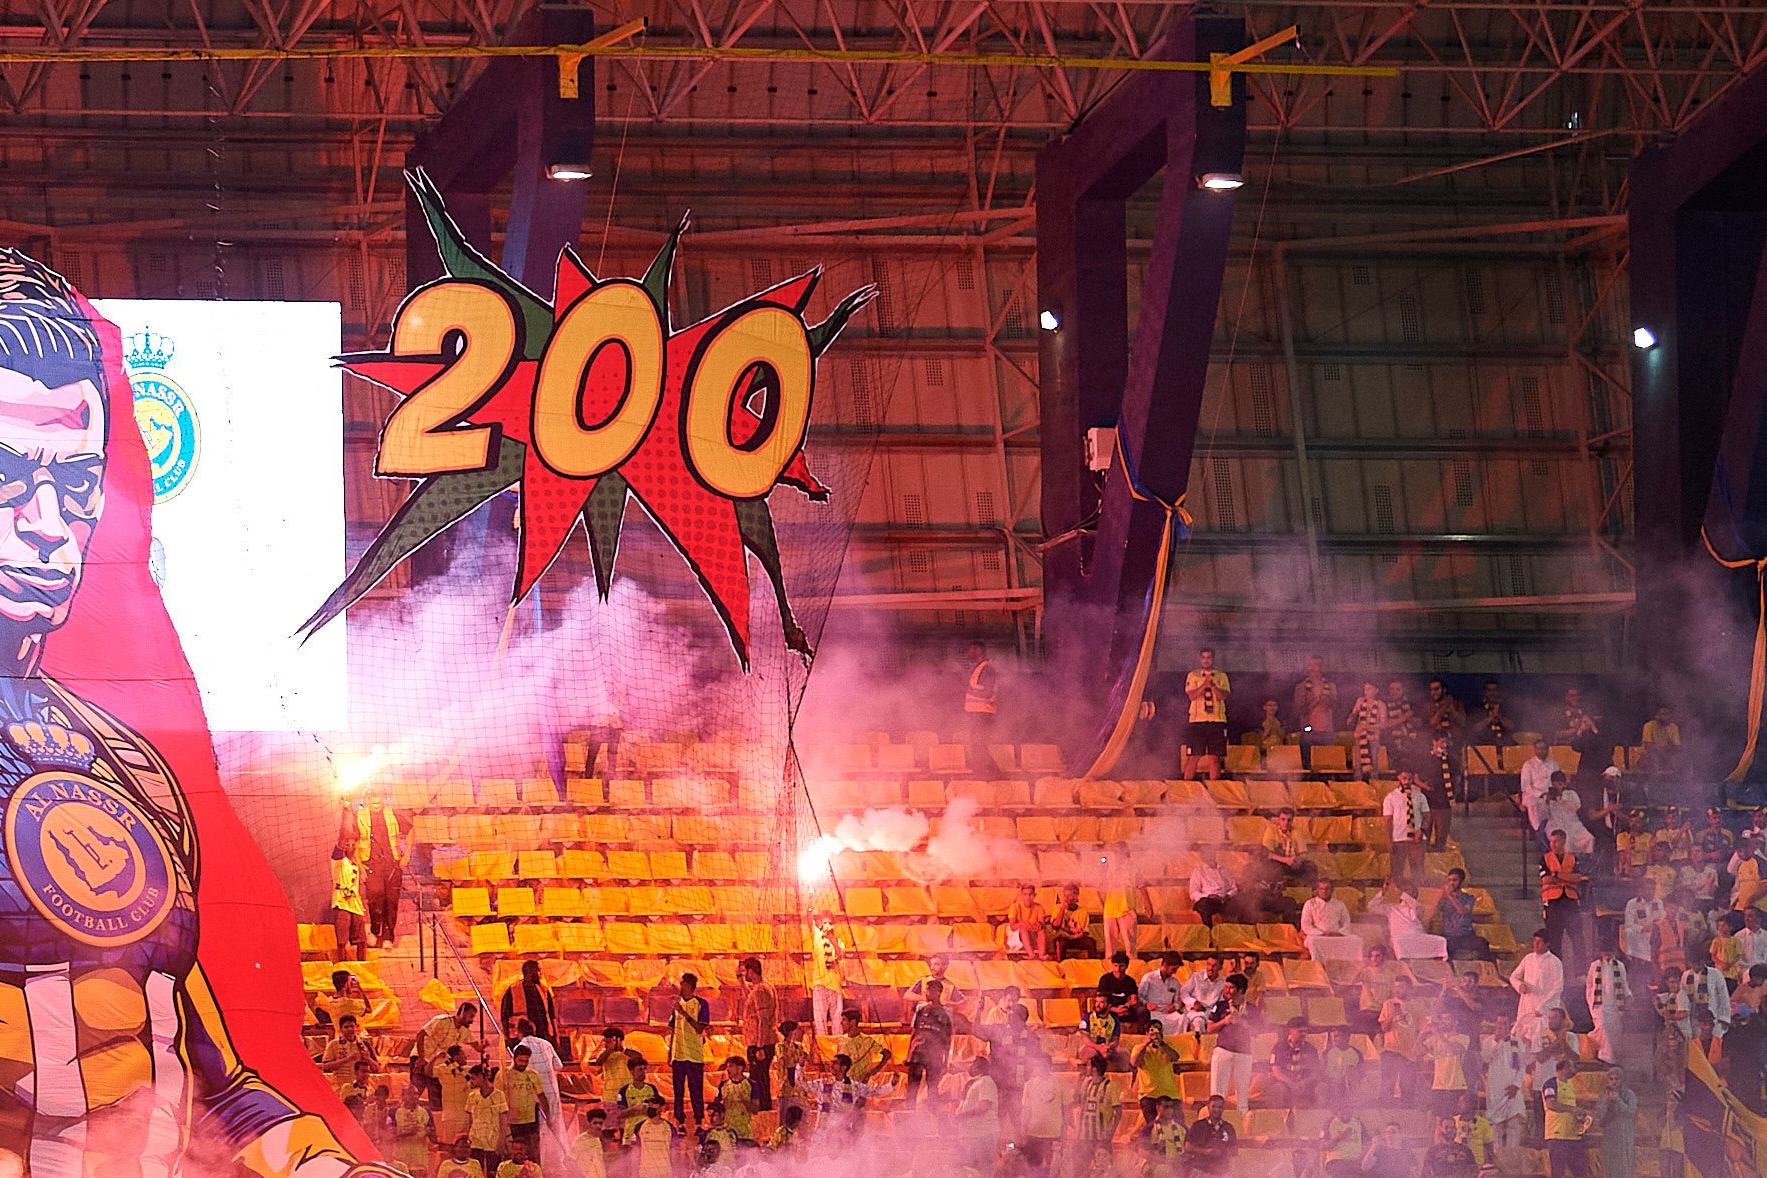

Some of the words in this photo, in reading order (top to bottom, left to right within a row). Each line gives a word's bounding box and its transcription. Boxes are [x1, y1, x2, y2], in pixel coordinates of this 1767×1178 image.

[376, 279, 815, 500] 200
[25, 792, 53, 822] AL
[48, 783, 137, 832] NASSR
[42, 882, 129, 931] FOOTBALL
[130, 886, 160, 923] CLUB
